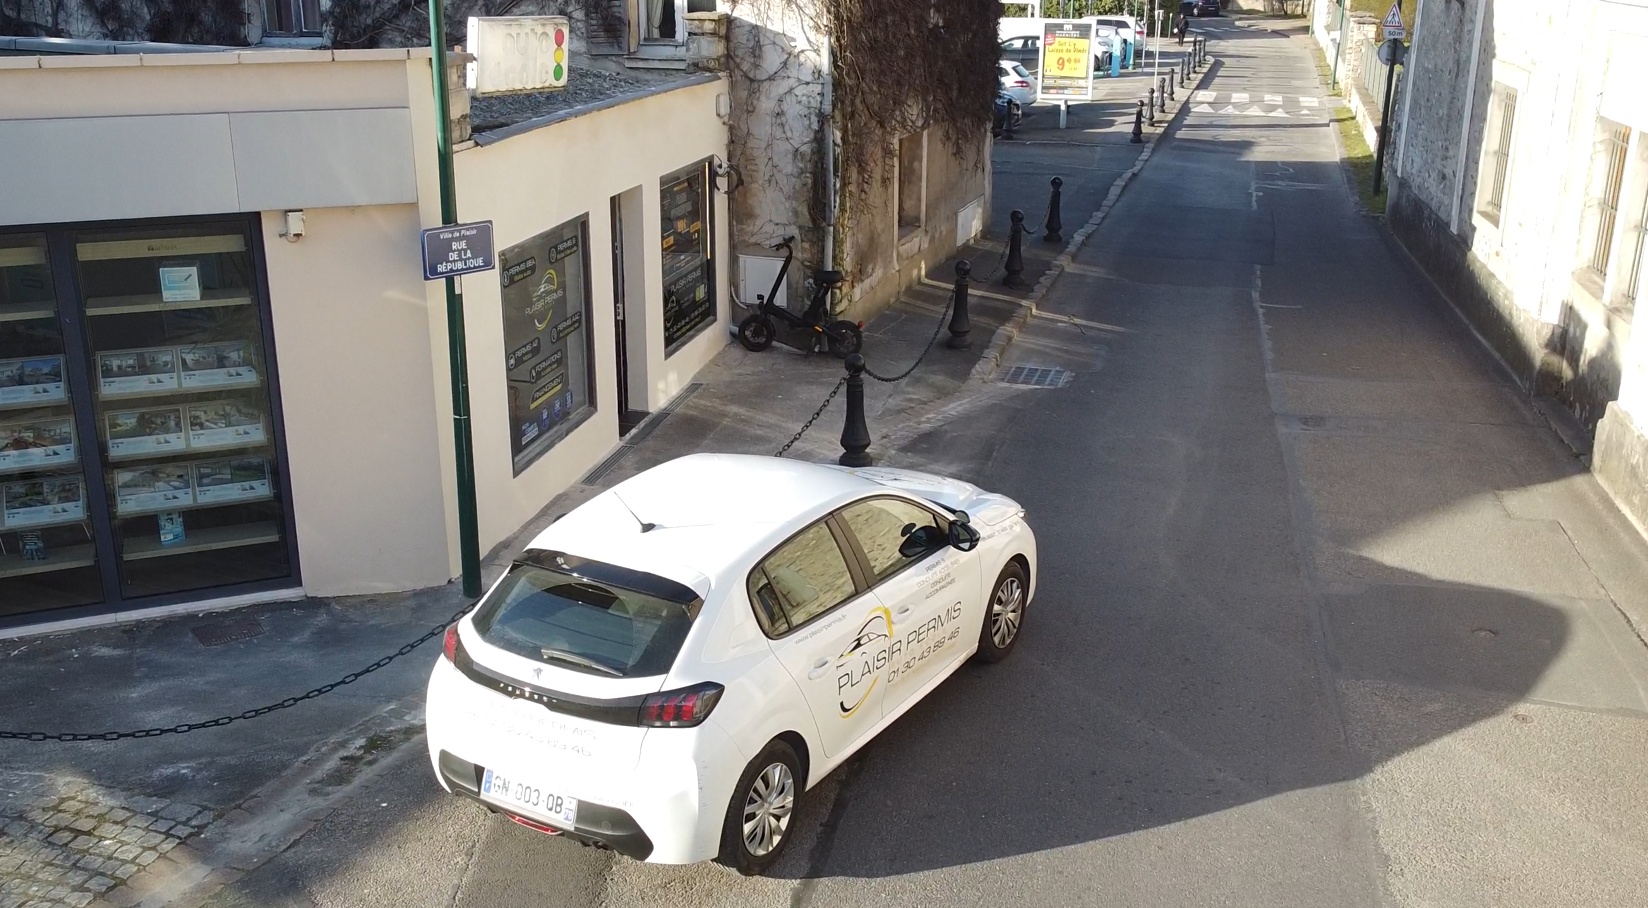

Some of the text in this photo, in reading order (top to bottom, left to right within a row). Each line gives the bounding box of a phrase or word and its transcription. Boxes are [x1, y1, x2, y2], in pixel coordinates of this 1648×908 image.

[440, 231, 452, 239] Ville
[461, 229, 477, 237] Plaisir
[452, 240, 467, 251] RUE
[449, 249, 472, 261] DE LA
[437, 257, 484, 273] RÉPUBLIQUE
[525, 299, 545, 316] PLAISIR
[545, 289, 564, 304] PERMIS
[837, 600, 962, 696] PLAISIR PERMIS
[887, 626, 960, 684] 01 30 43 89 46
